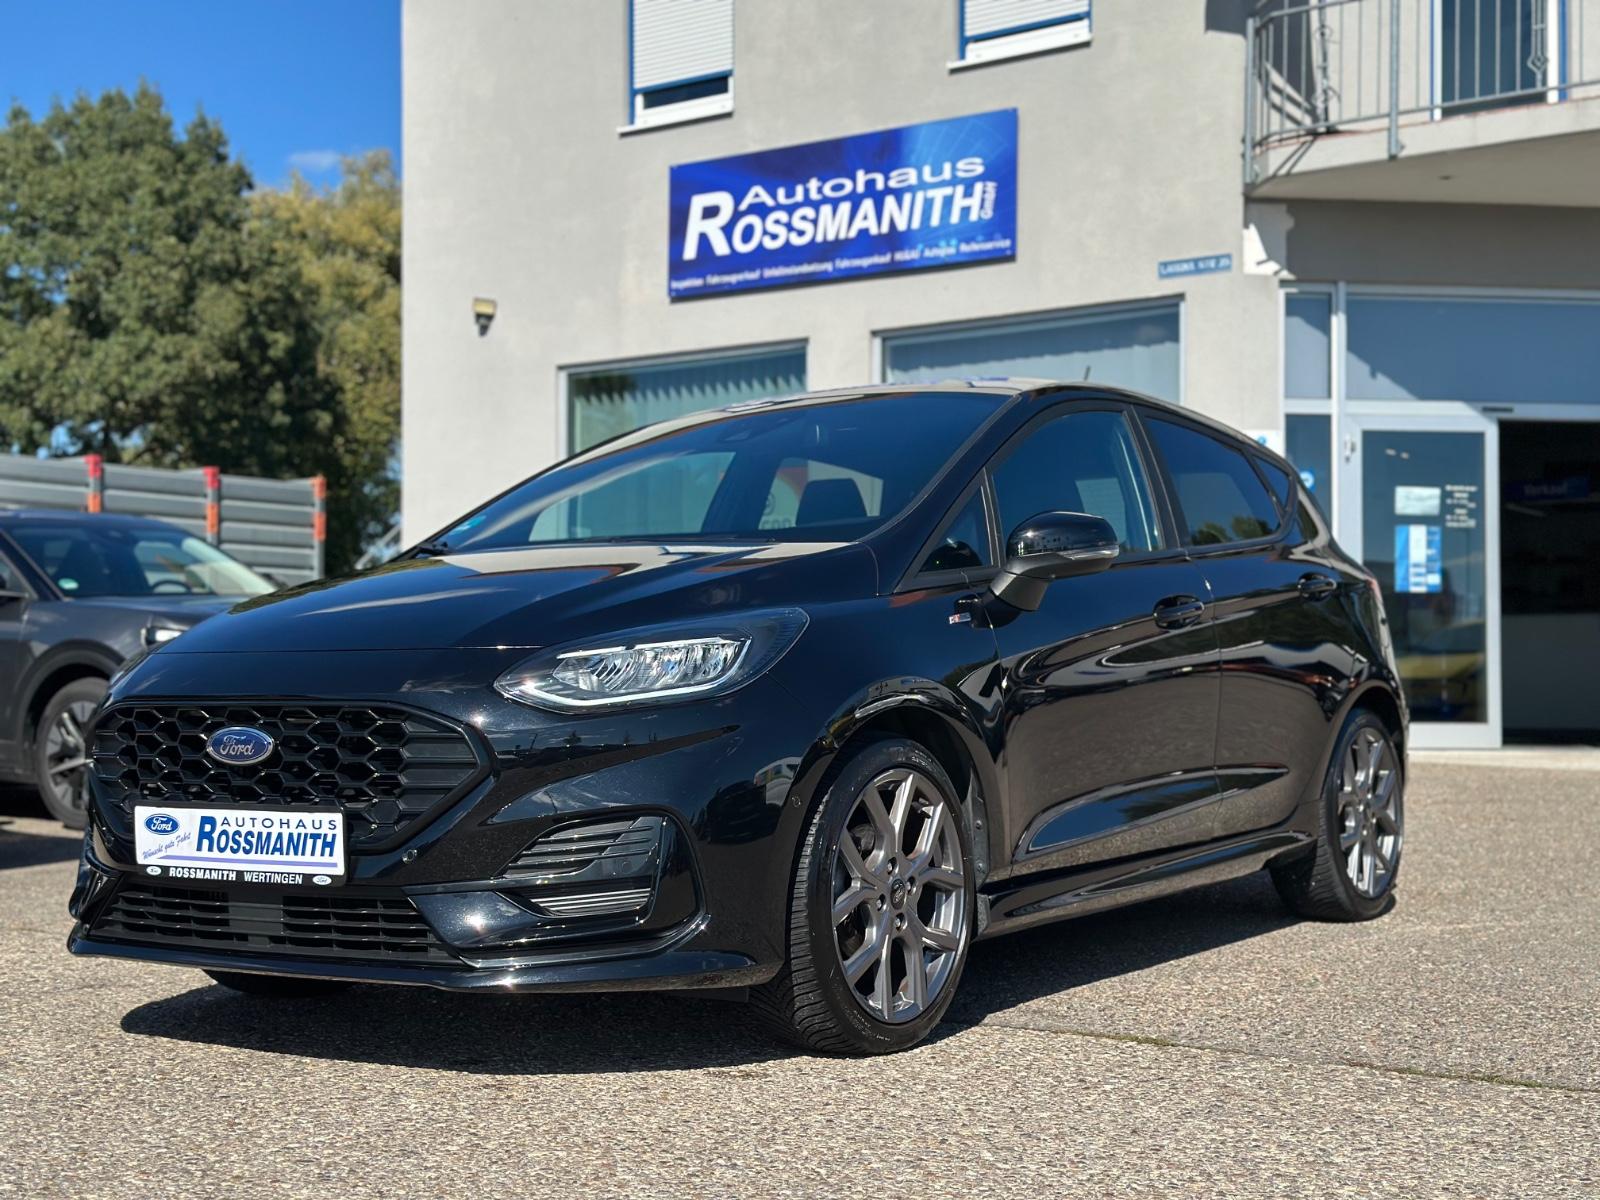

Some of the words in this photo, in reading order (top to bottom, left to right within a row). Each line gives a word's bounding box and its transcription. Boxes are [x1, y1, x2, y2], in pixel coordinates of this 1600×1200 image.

[737, 156, 986, 212] Autohaus
[220, 734, 255, 756] Ford
[151, 816, 173, 831] Ford
[220, 816, 337, 831] AUTOHAUS
[196, 815, 337, 857] ROSSMANITH
[169, 866, 237, 881] ROSSMANITH
[243, 871, 303, 885] WERTINGEN
